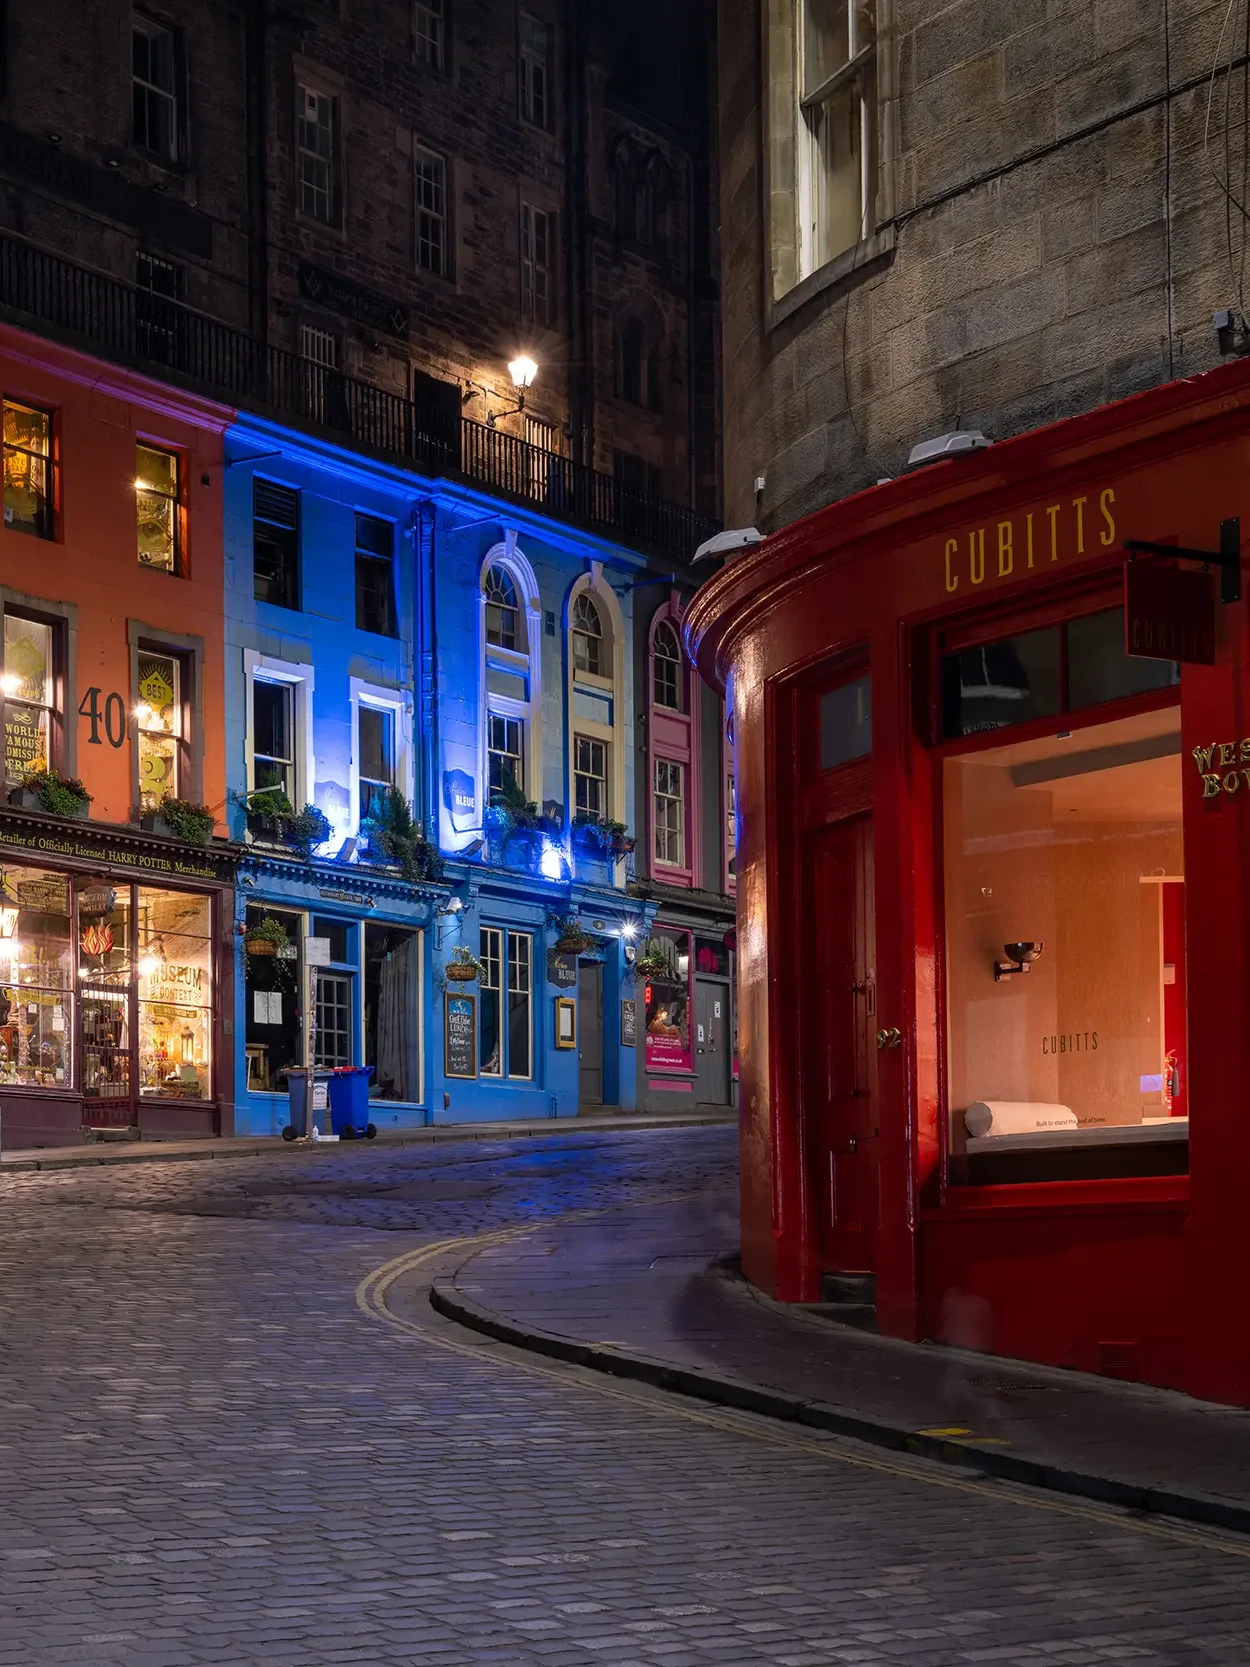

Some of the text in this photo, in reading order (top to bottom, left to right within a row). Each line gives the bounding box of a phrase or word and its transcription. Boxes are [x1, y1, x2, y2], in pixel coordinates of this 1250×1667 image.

[945, 488, 1117, 593] CUBITTS
[1132, 619, 1210, 658] CUBITTS
[146, 683, 167, 700] BEST
[78, 686, 126, 749] 40
[4, 723, 40, 739] WORLD
[27, 836, 36, 847] of
[38, 837, 74, 856] Officially
[75, 844, 106, 860] Licensed
[108, 850, 138, 865] HARRY
[139, 855, 172, 871] POTTER
[174, 861, 217, 878] Merchandise
[150, 965, 202, 991] MUSEUM
[160, 986, 192, 1001] CONTEXT
[1042, 1031, 1098, 1055] CUBITTS
